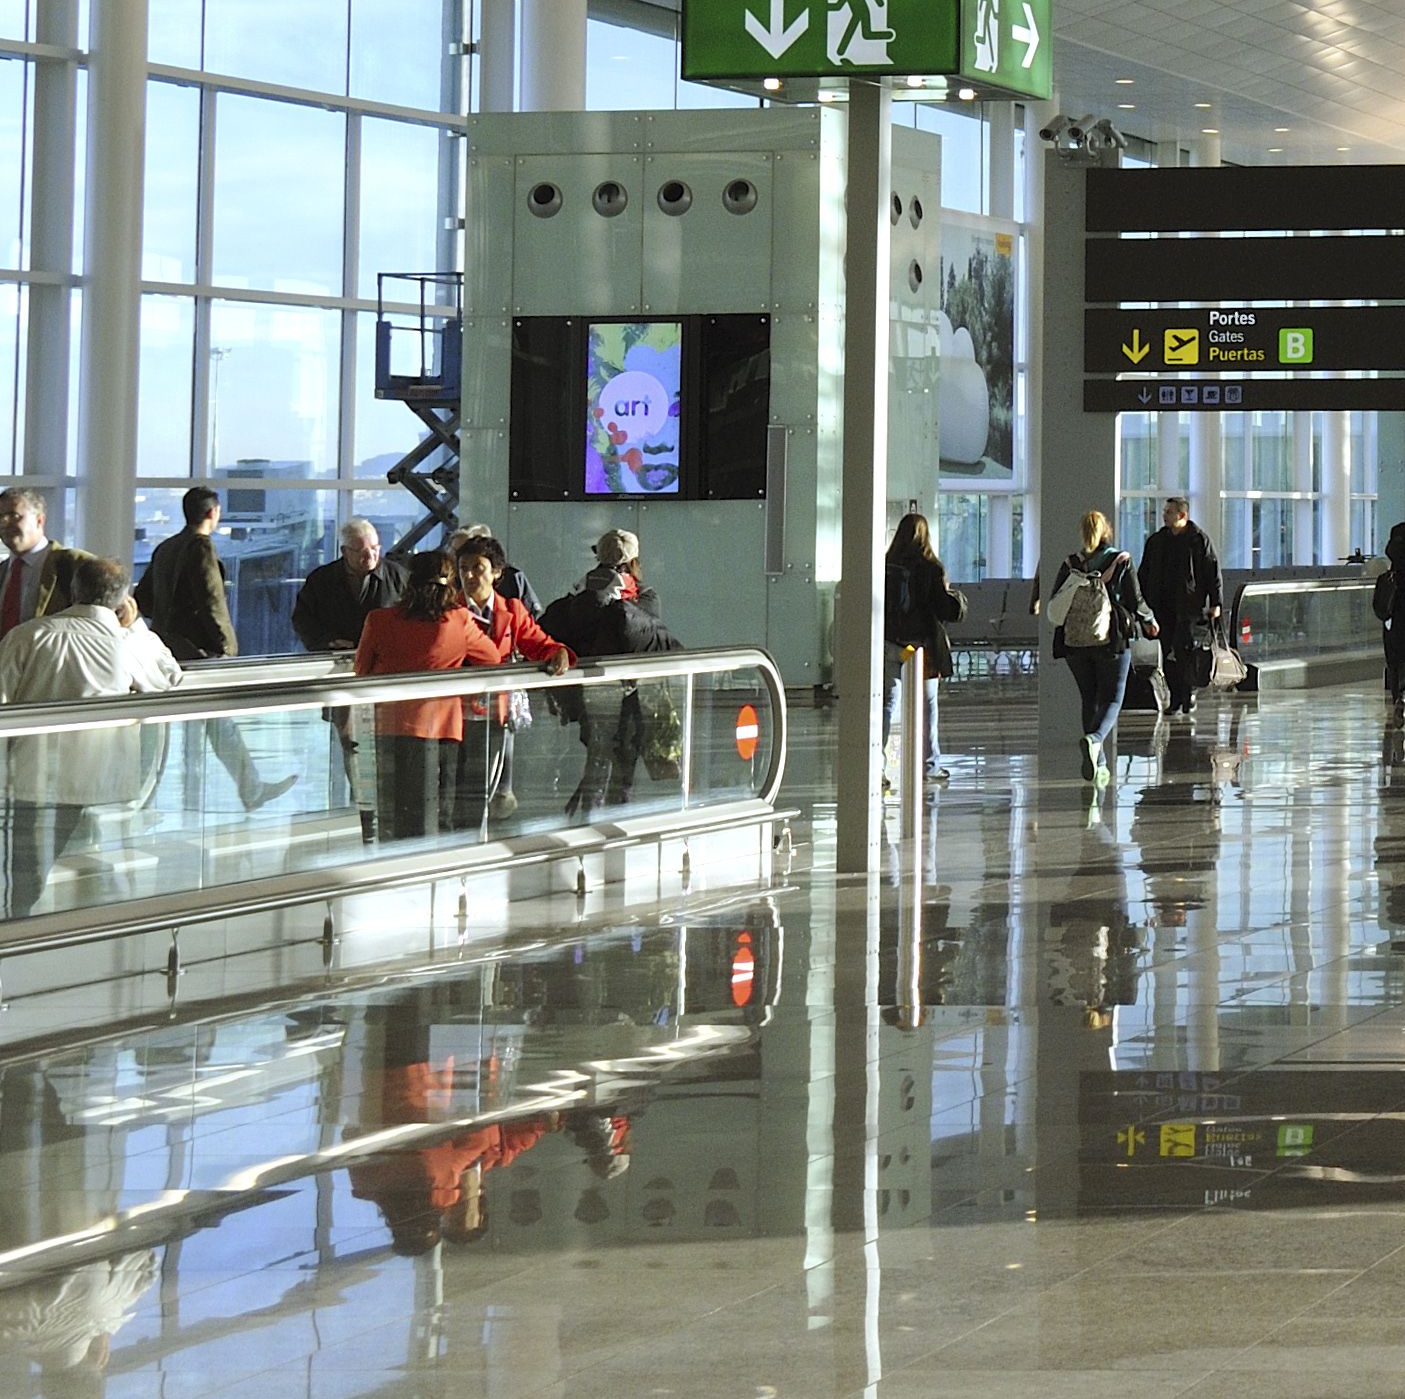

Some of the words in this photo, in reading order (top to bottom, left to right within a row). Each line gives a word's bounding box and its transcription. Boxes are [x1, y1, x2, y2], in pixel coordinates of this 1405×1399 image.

[1209, 311, 1256, 325] Portes
[1208, 330, 1245, 343] Gates
[1286, 332, 1305, 359] B
[1209, 347, 1266, 361] Puertas
